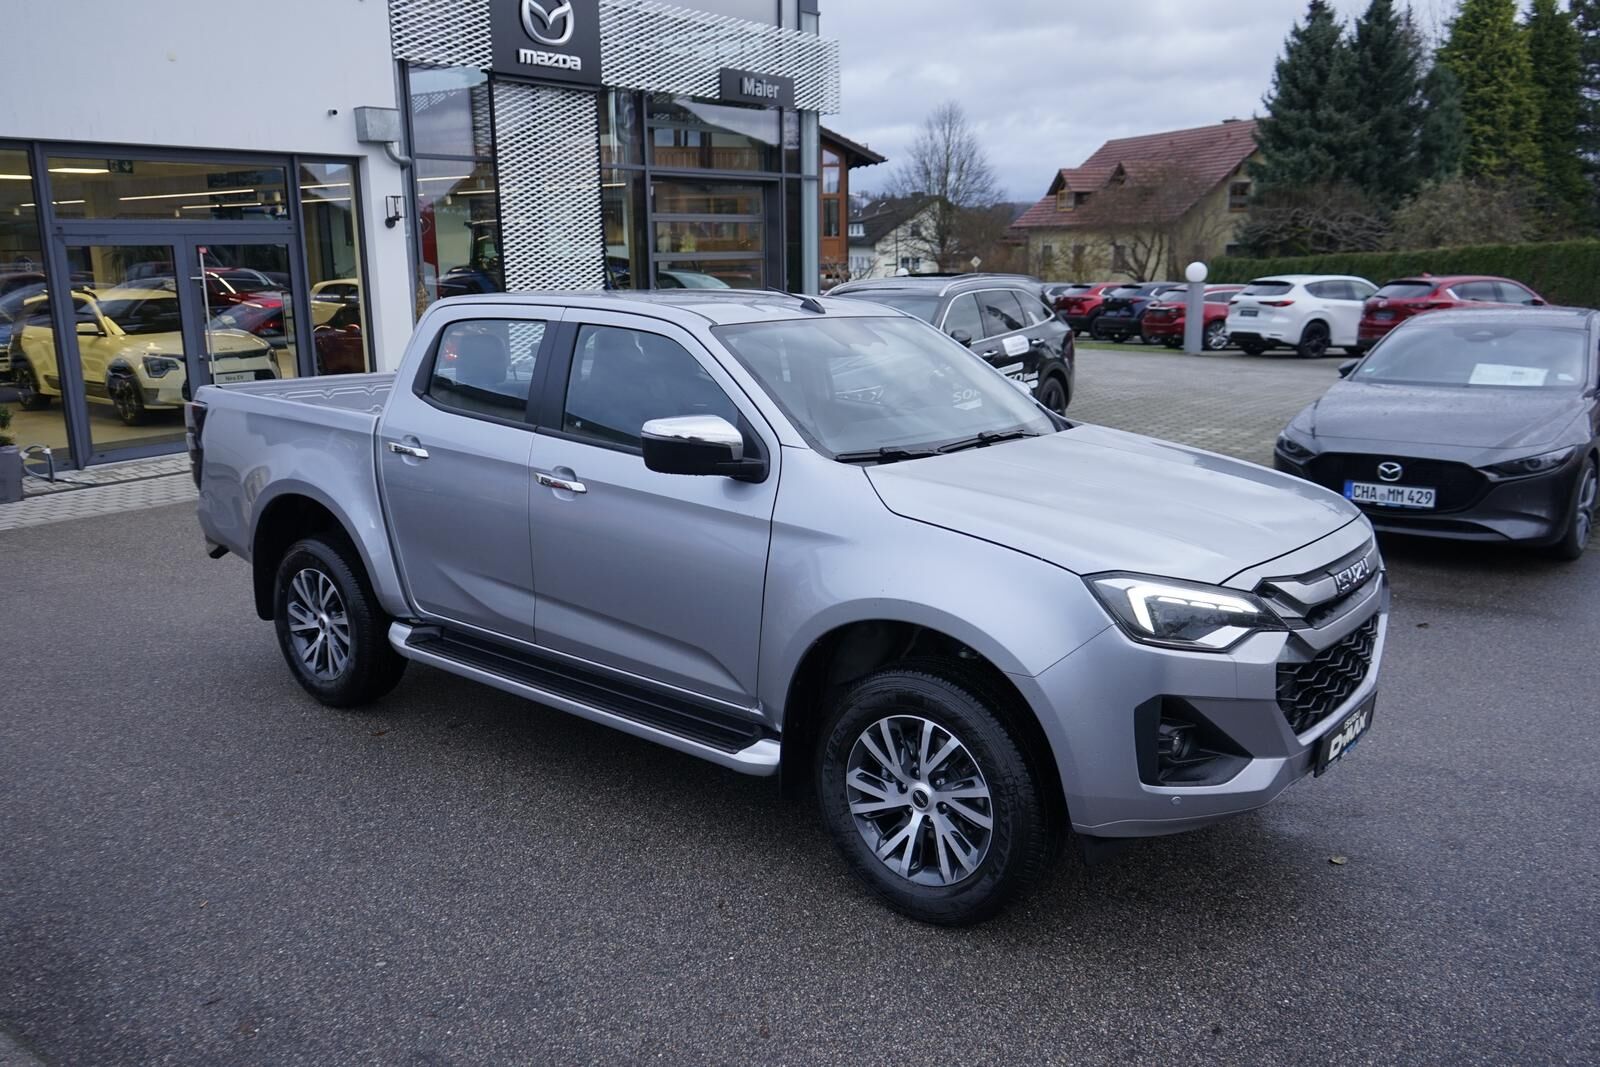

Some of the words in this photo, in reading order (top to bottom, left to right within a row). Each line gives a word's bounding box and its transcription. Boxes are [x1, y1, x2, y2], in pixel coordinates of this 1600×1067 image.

[743, 77, 780, 99] Maier
[1353, 484, 1377, 500] CHA
[1387, 487, 1405, 503] MM
[1407, 489, 1433, 505] 429
[1335, 557, 1370, 591] ISUZU
